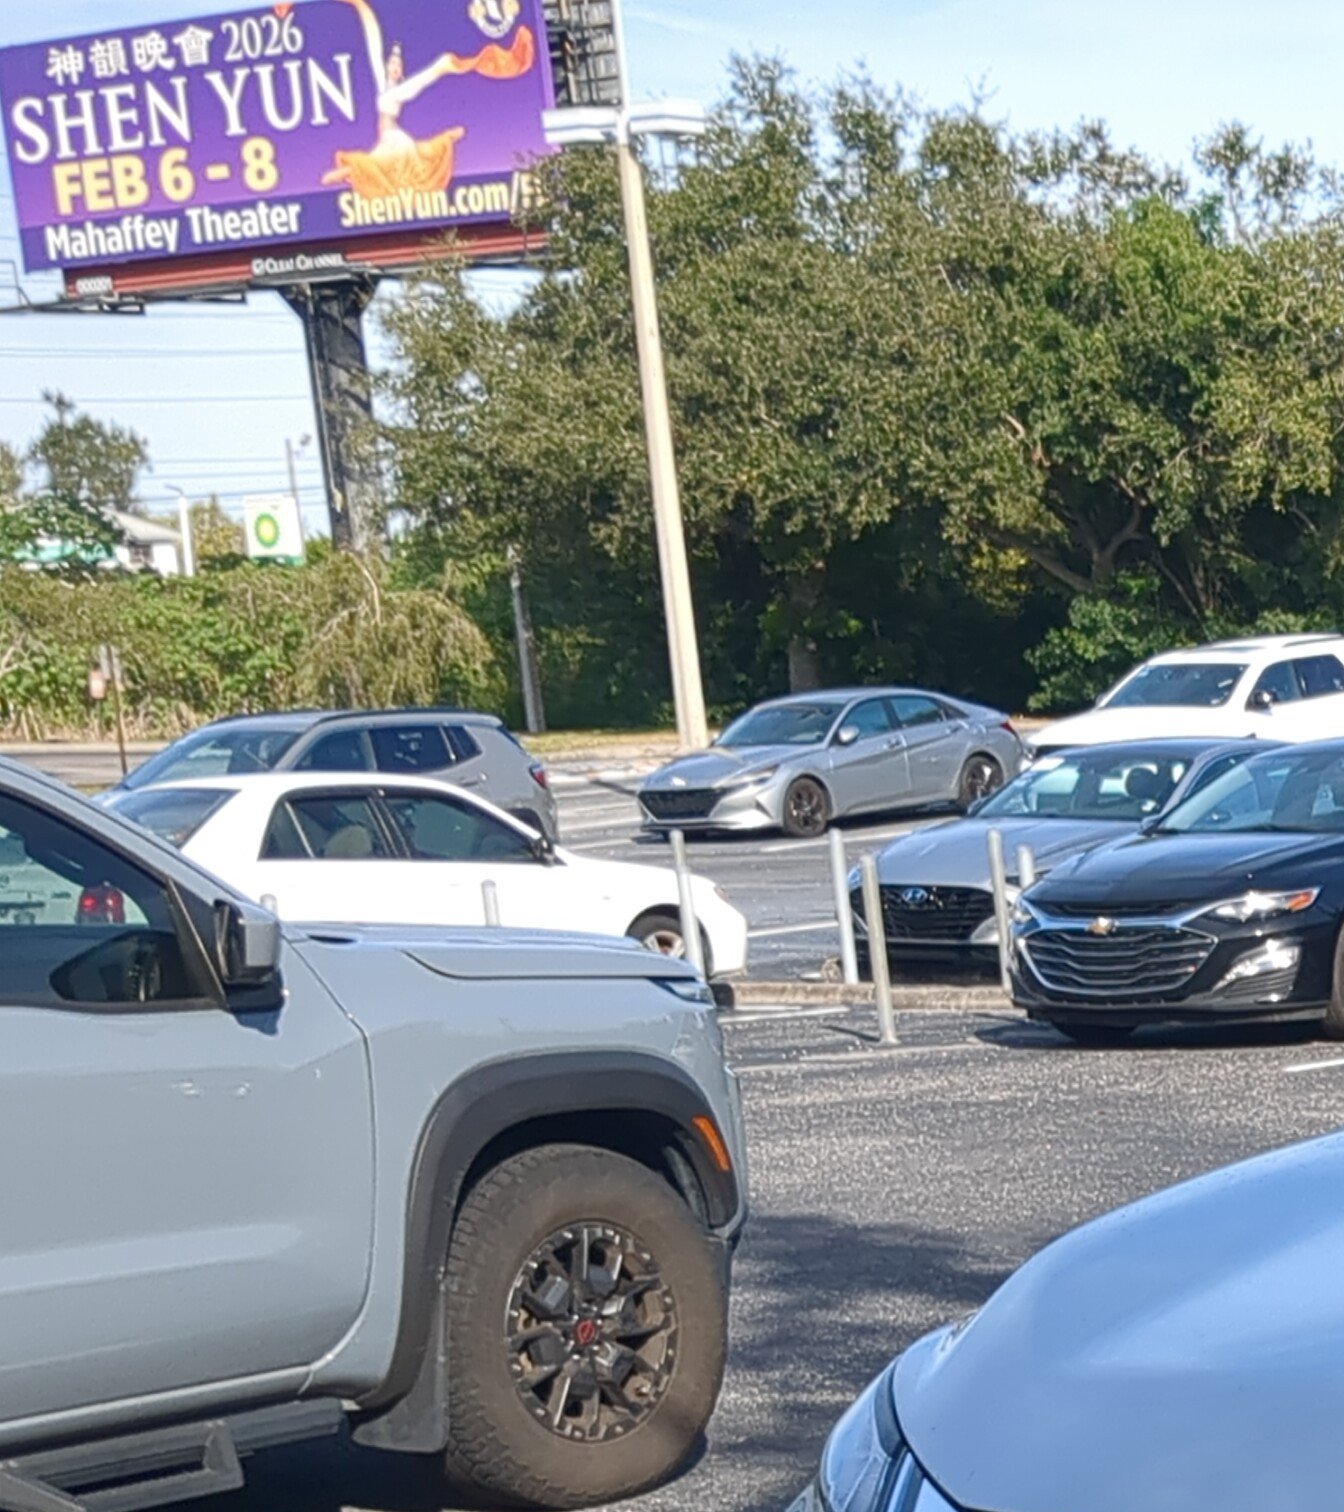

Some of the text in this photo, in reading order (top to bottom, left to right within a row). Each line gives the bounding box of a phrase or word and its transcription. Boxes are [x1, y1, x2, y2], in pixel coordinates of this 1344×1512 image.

[46, 14, 303, 86] 神韻晚會 2026
[11, 54, 356, 164] SHEN YUN
[53, 153, 151, 216] FEB
[159, 147, 195, 203] 6
[241, 136, 279, 192] 8
[45, 201, 301, 260] Mahaffey Theater
